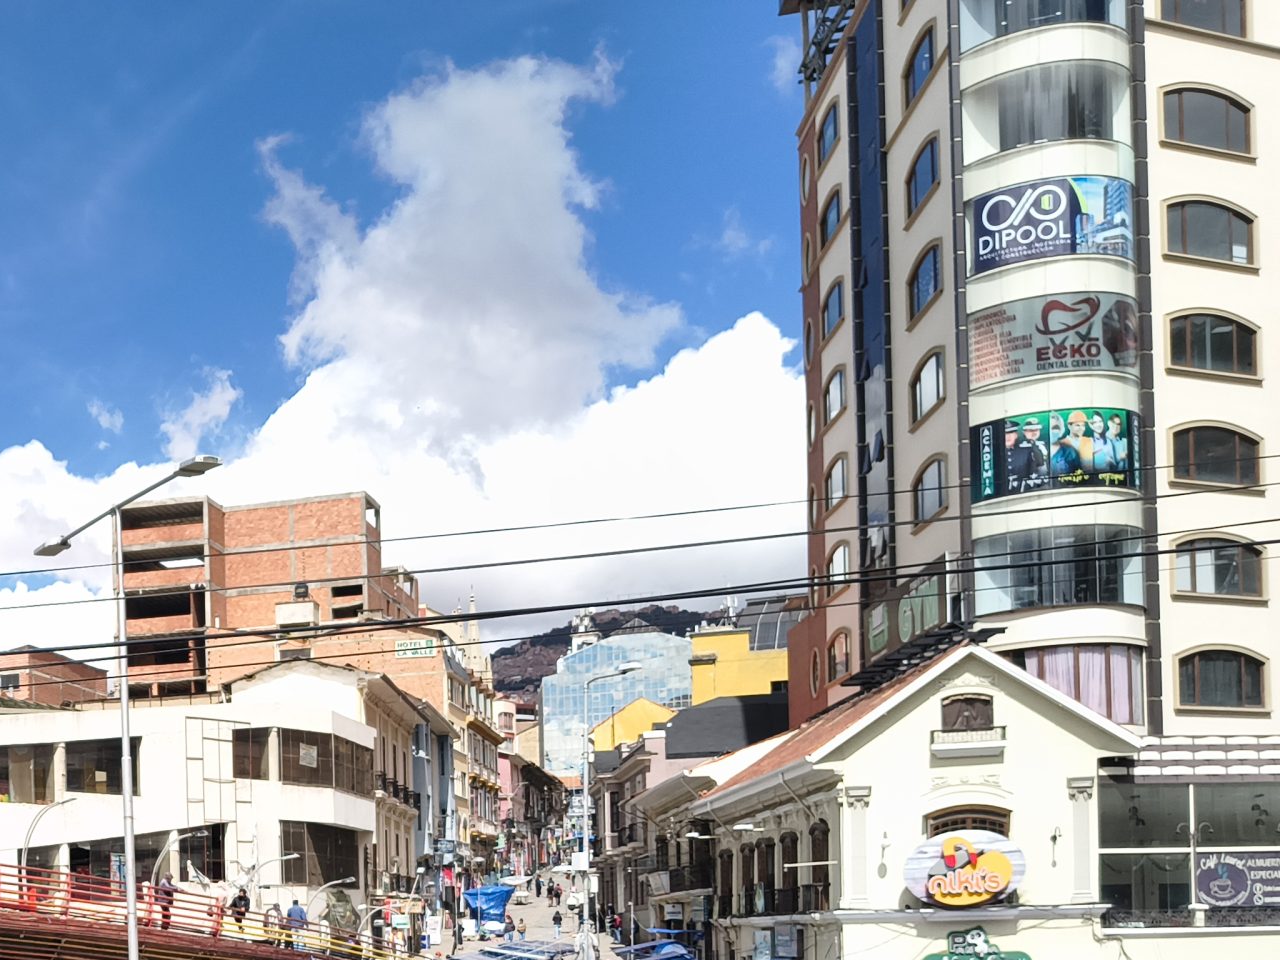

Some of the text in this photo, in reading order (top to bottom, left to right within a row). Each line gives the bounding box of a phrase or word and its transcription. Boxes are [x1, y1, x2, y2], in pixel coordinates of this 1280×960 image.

[979, 220, 1072, 255] DIPOOL
[1036, 358, 1102, 371] DENTAL CENTER
[981, 428, 994, 496] ACADEMIA
[898, 575, 939, 643] GYM
[928, 867, 1001, 894] niki's
